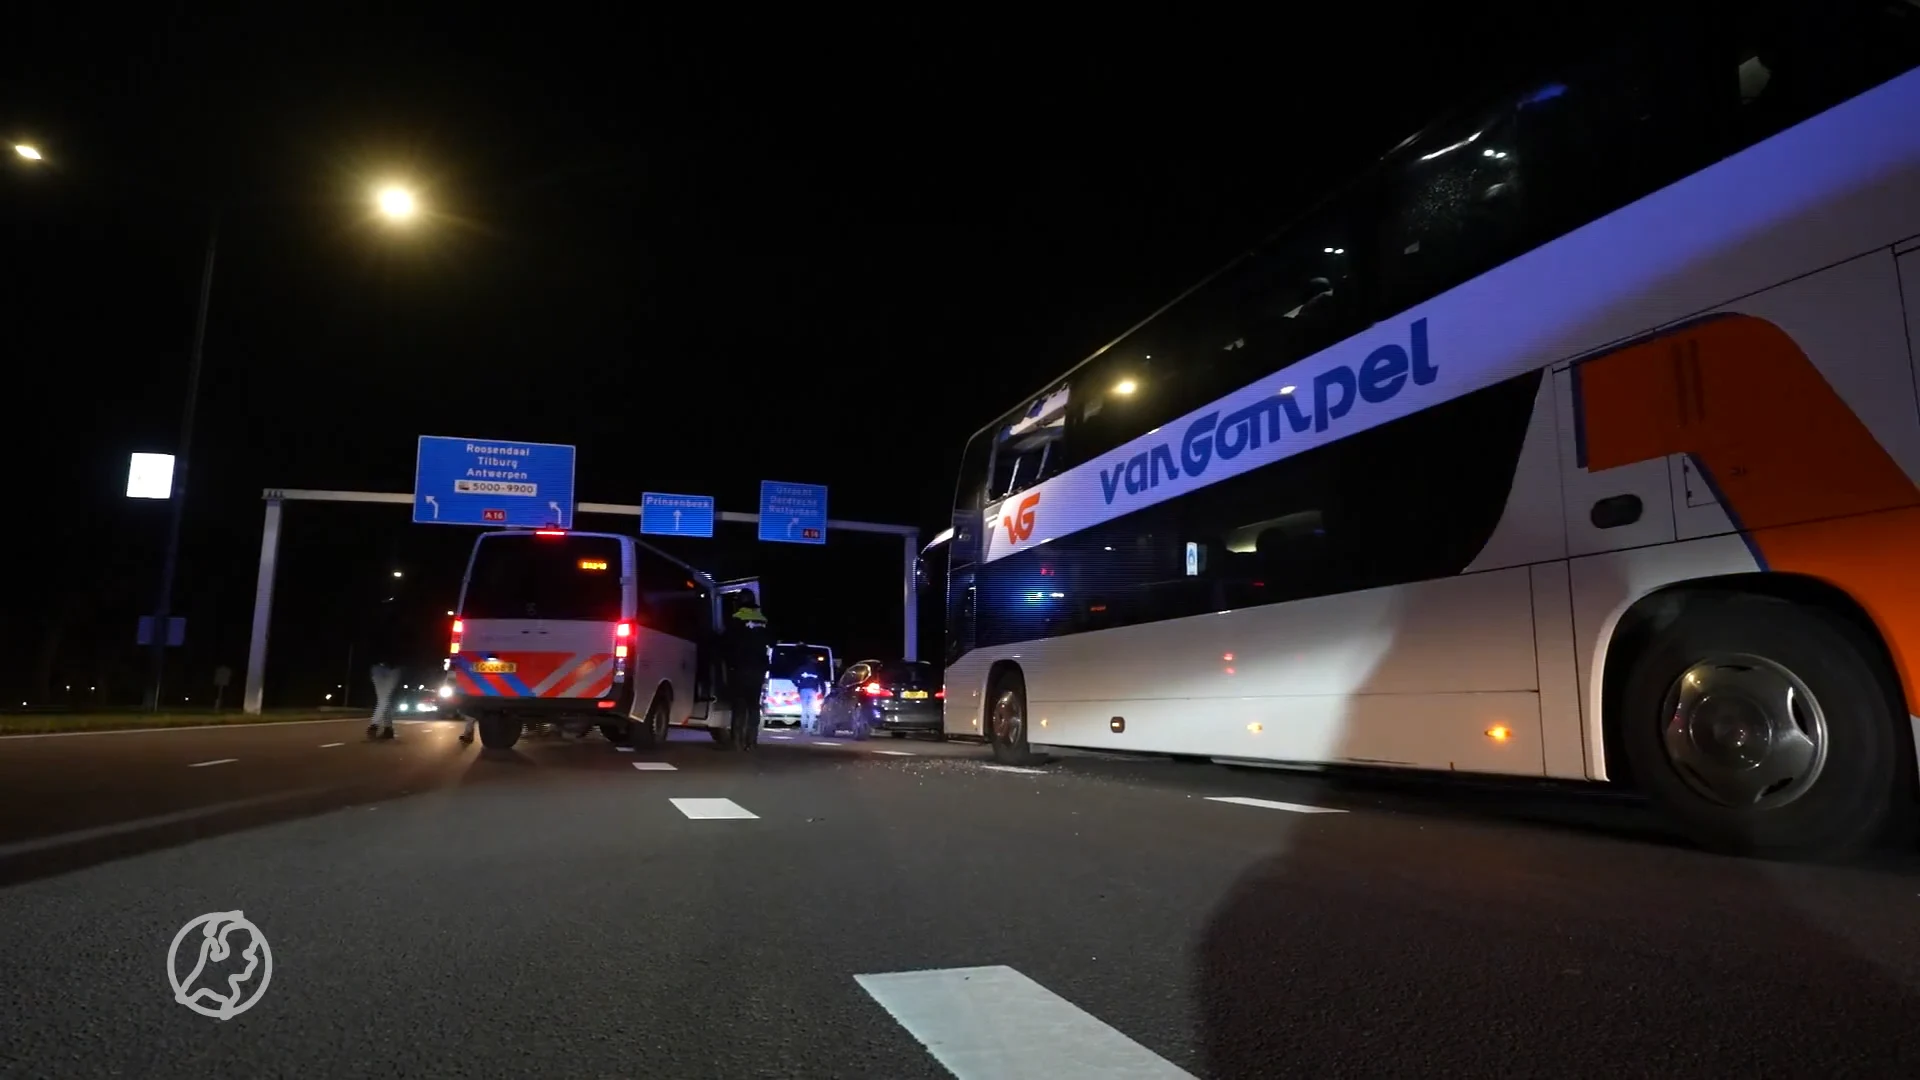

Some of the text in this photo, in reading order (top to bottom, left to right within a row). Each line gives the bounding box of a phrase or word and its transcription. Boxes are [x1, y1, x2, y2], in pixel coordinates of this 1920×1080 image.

[466, 444, 530, 456] Roosendaal
[478, 456, 518, 469] Tilburg
[466, 468, 528, 480] Antwerpen
